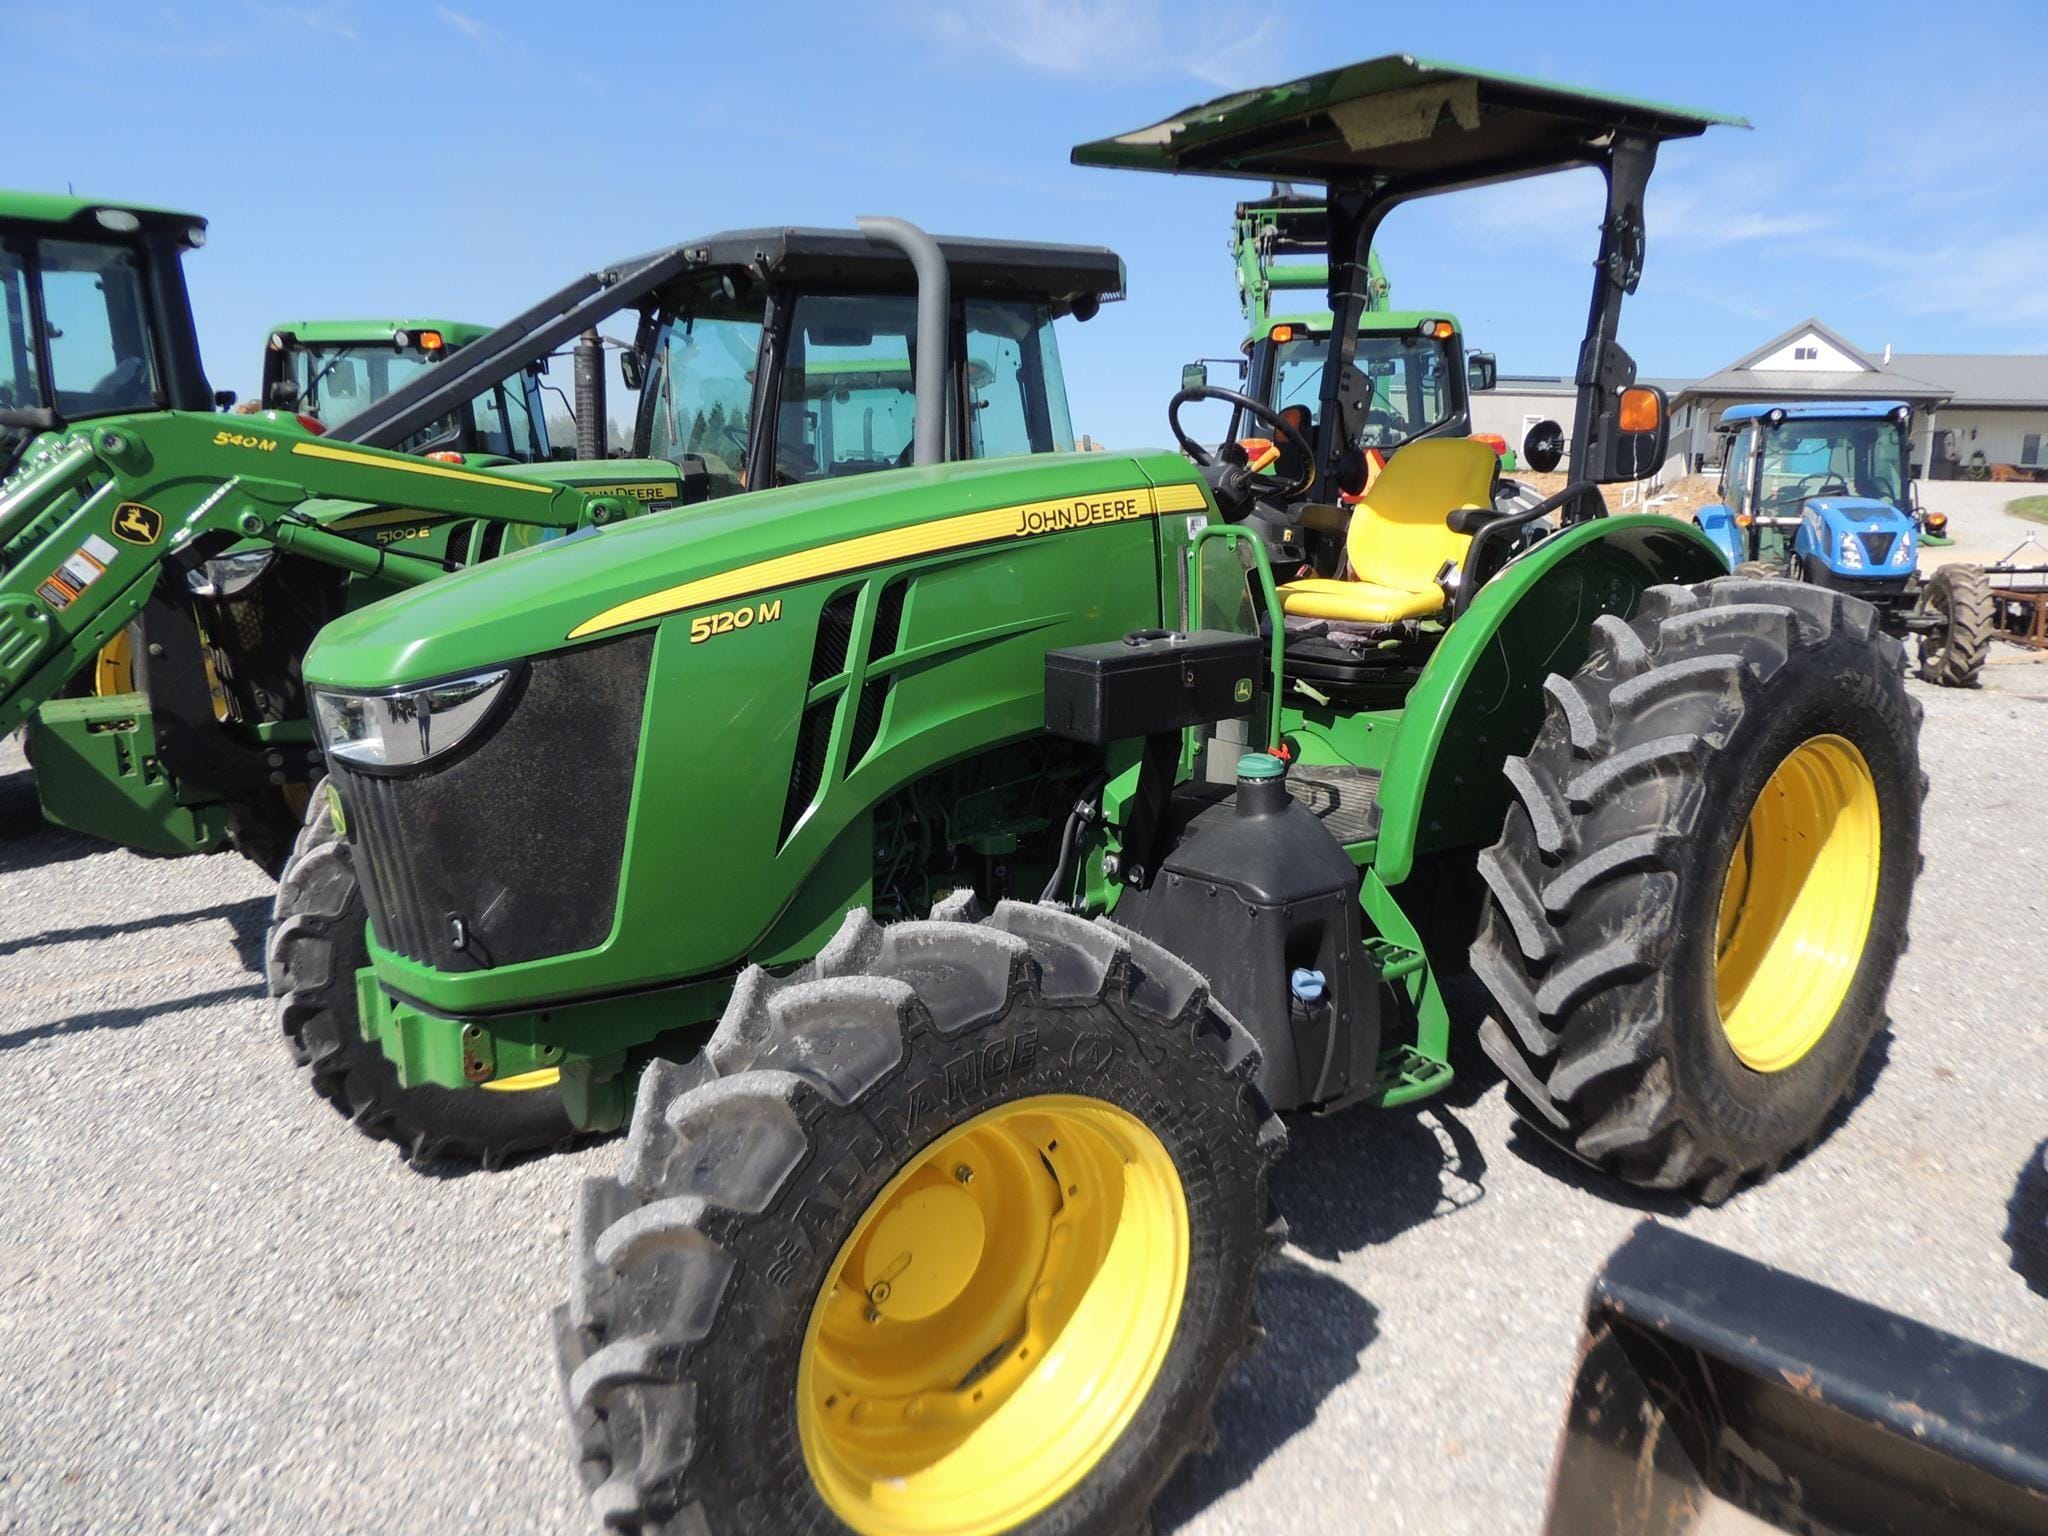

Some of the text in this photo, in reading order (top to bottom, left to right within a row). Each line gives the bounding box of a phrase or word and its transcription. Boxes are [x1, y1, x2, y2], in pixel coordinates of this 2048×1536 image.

[615, 487, 665, 499] DEERE
[1016, 498, 1138, 533] JOHN DEERE
[690, 599, 783, 644] 5120 M
[793, 1028, 1039, 1258] ALLIANCE
